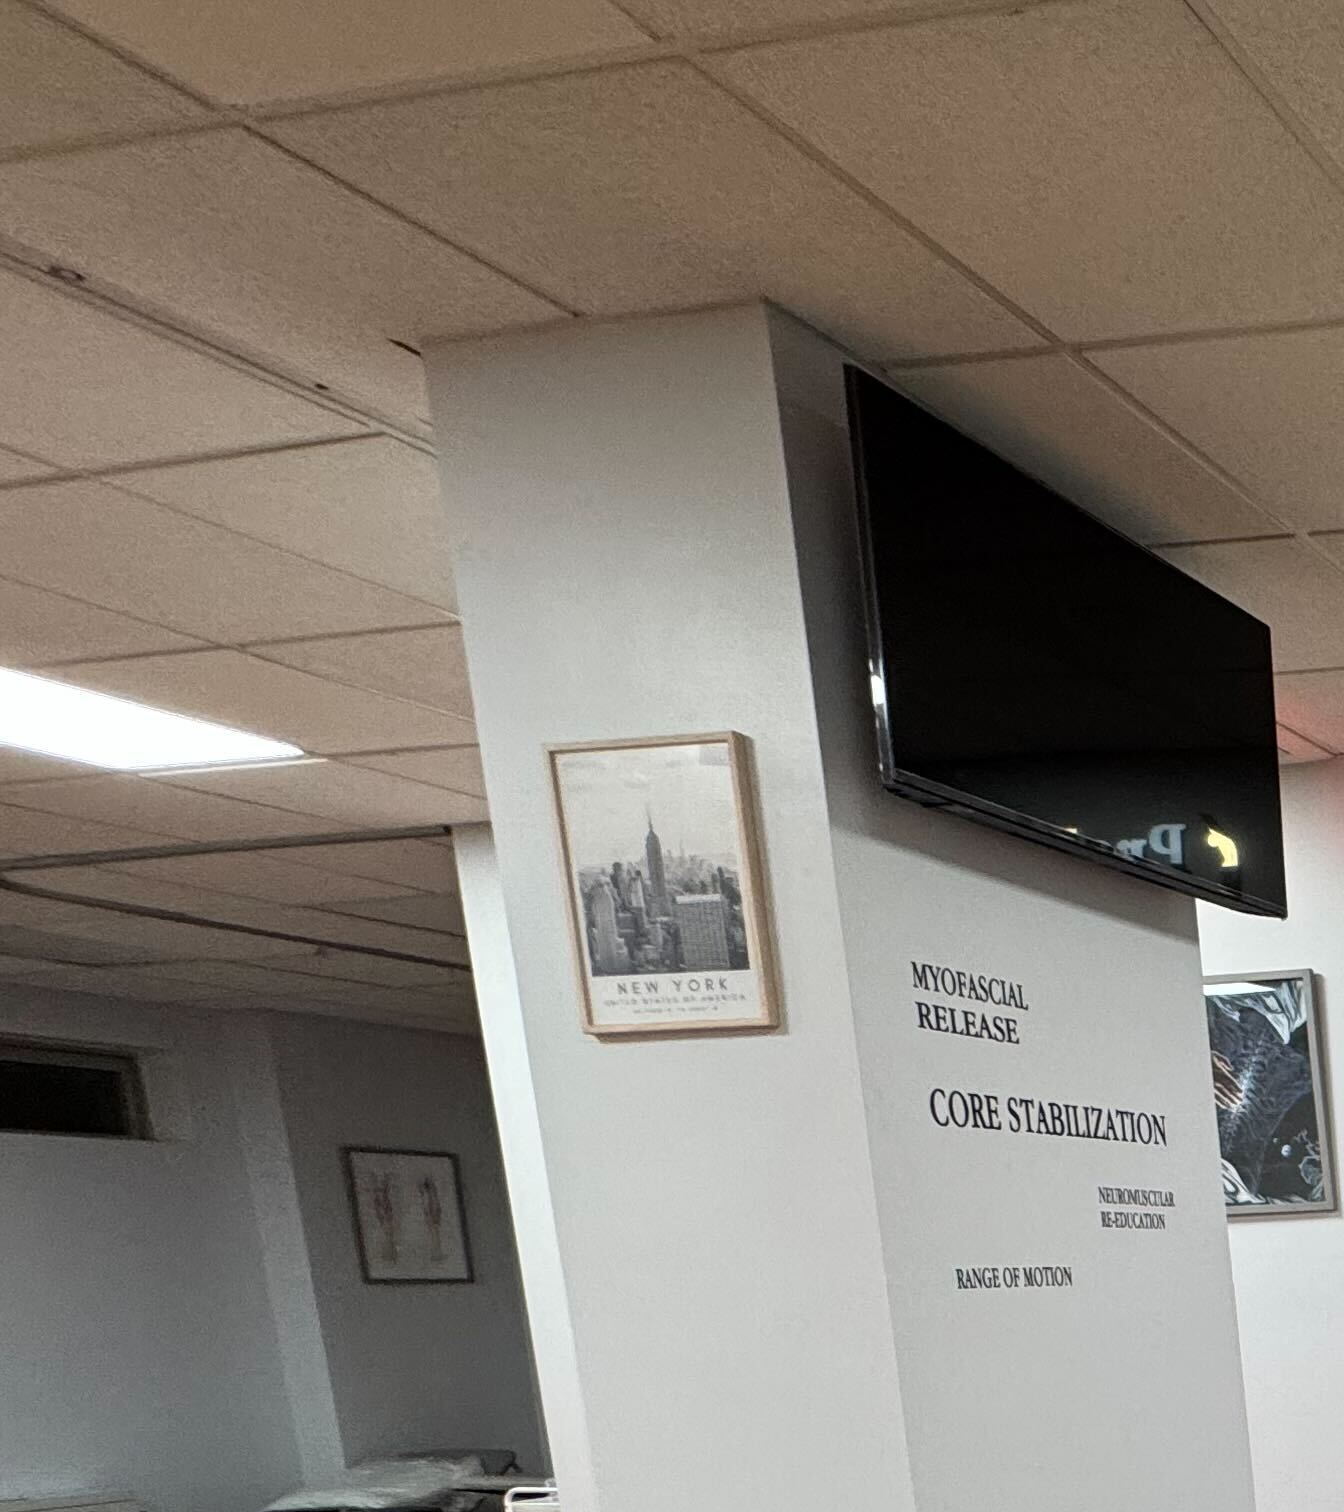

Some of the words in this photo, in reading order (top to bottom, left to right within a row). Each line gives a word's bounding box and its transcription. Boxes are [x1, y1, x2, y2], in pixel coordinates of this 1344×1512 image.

[616, 981, 659, 995] NEW
[671, 977, 728, 993] YORK
[910, 961, 1029, 1011] MYOFASCIAL
[914, 1001, 1020, 1044] RELEASE
[929, 1088, 1002, 1131] CORE
[1007, 1096, 1167, 1147] STABILIZATION
[1098, 1186, 1176, 1207] NEUROMUSCULAR
[1100, 1211, 1166, 1230] RE-EDUCATION
[955, 1268, 1001, 1290] RANGE
[1003, 1267, 1020, 1289] OF
[1023, 1266, 1073, 1288] MOTION
